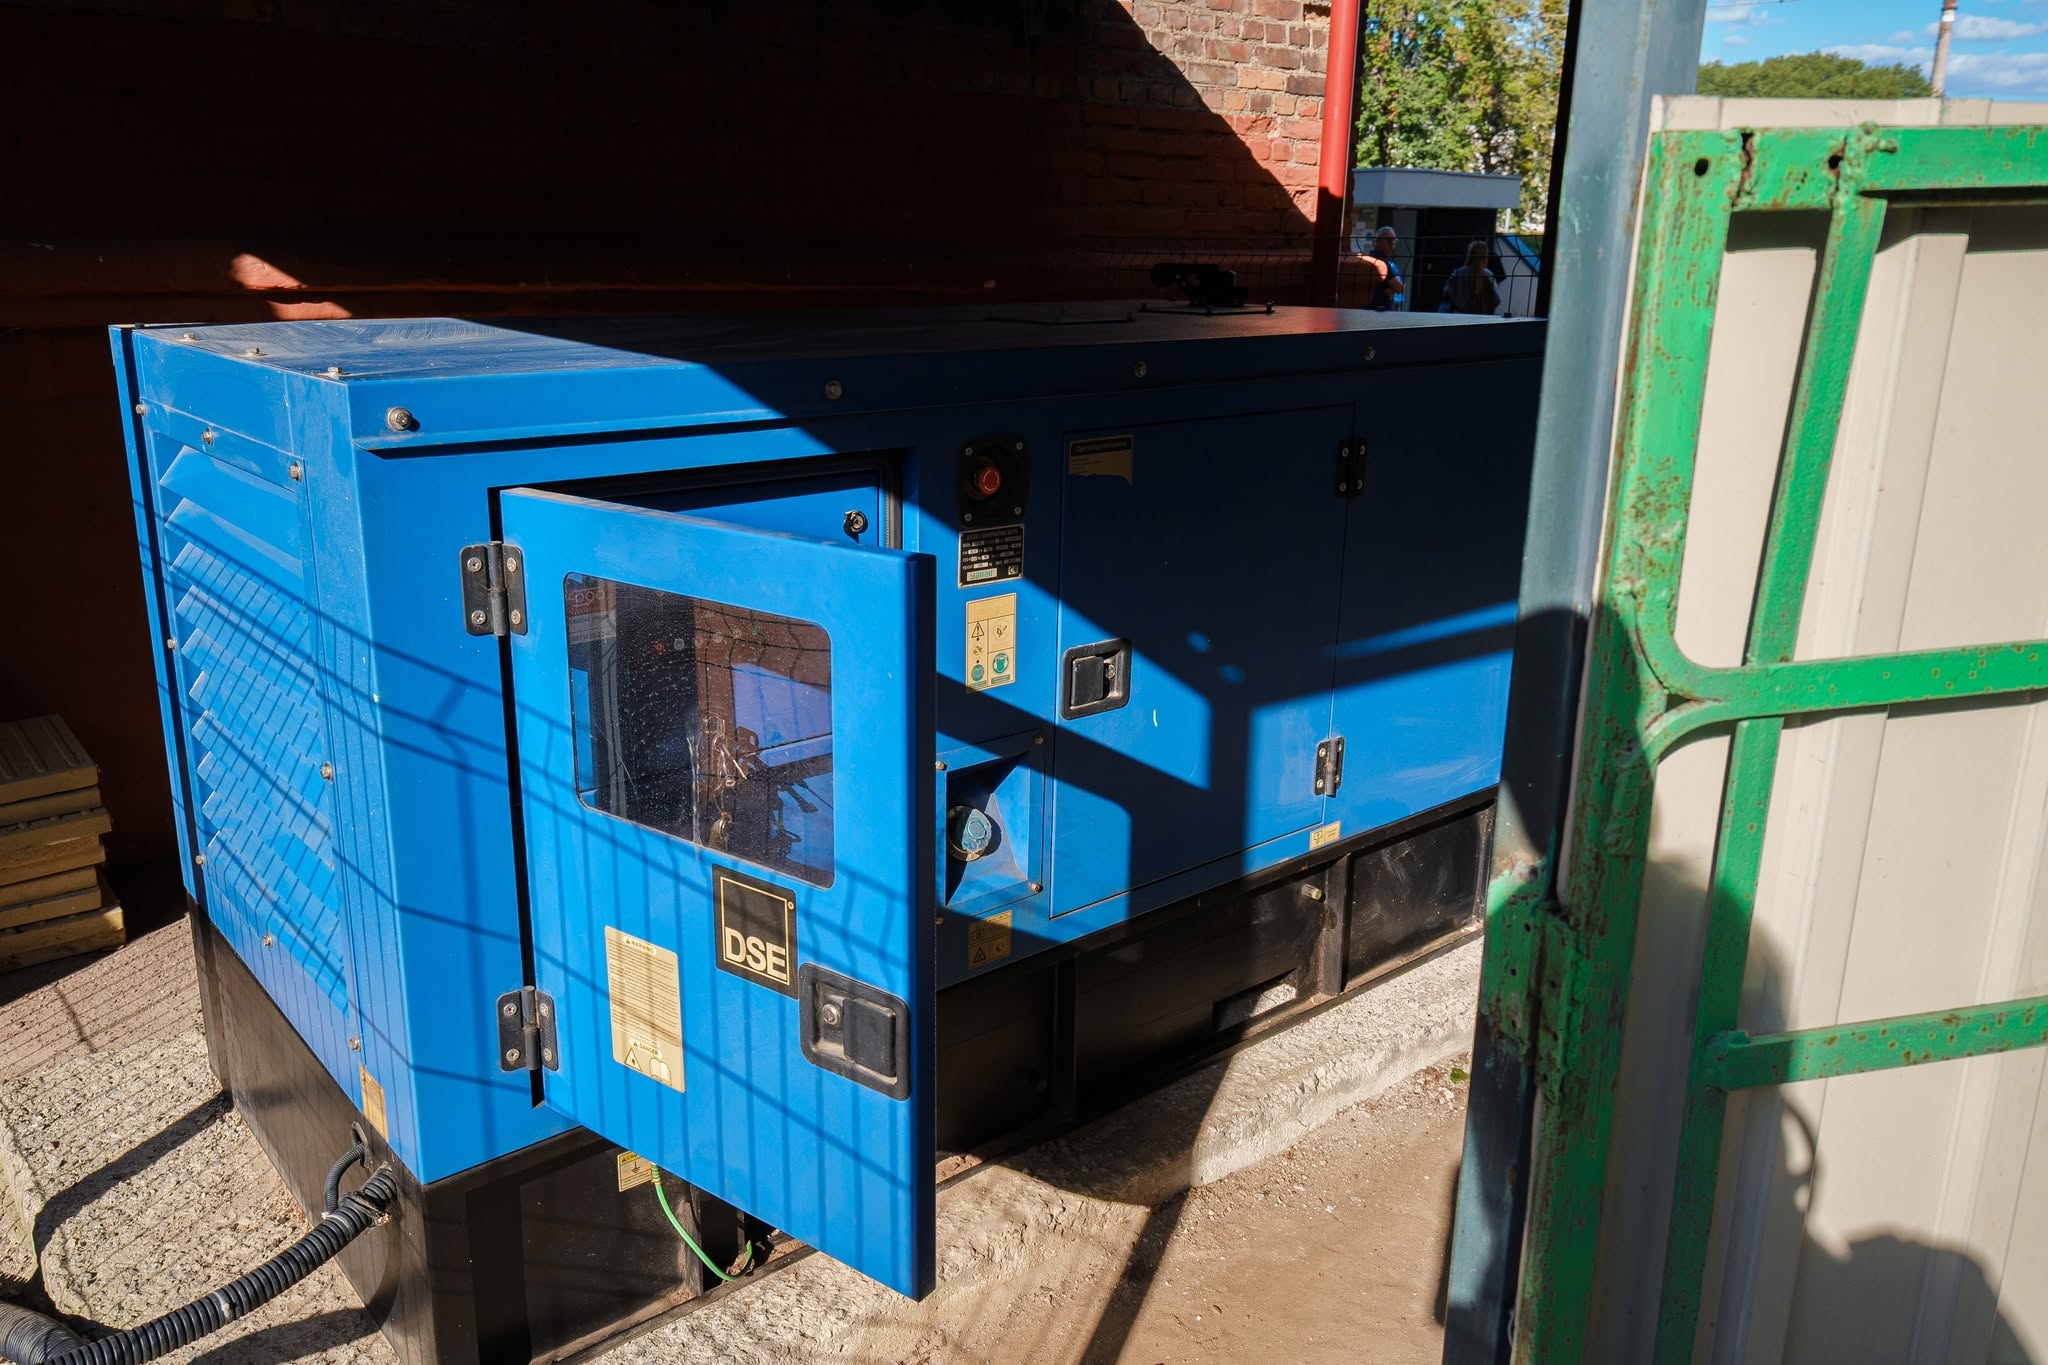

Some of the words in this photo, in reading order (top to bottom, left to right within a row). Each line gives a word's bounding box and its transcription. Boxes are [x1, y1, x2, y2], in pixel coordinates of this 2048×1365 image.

[631, 939, 655, 954] WARNING
[724, 926, 787, 981] DSE
[639, 1042, 659, 1056] DANGER
